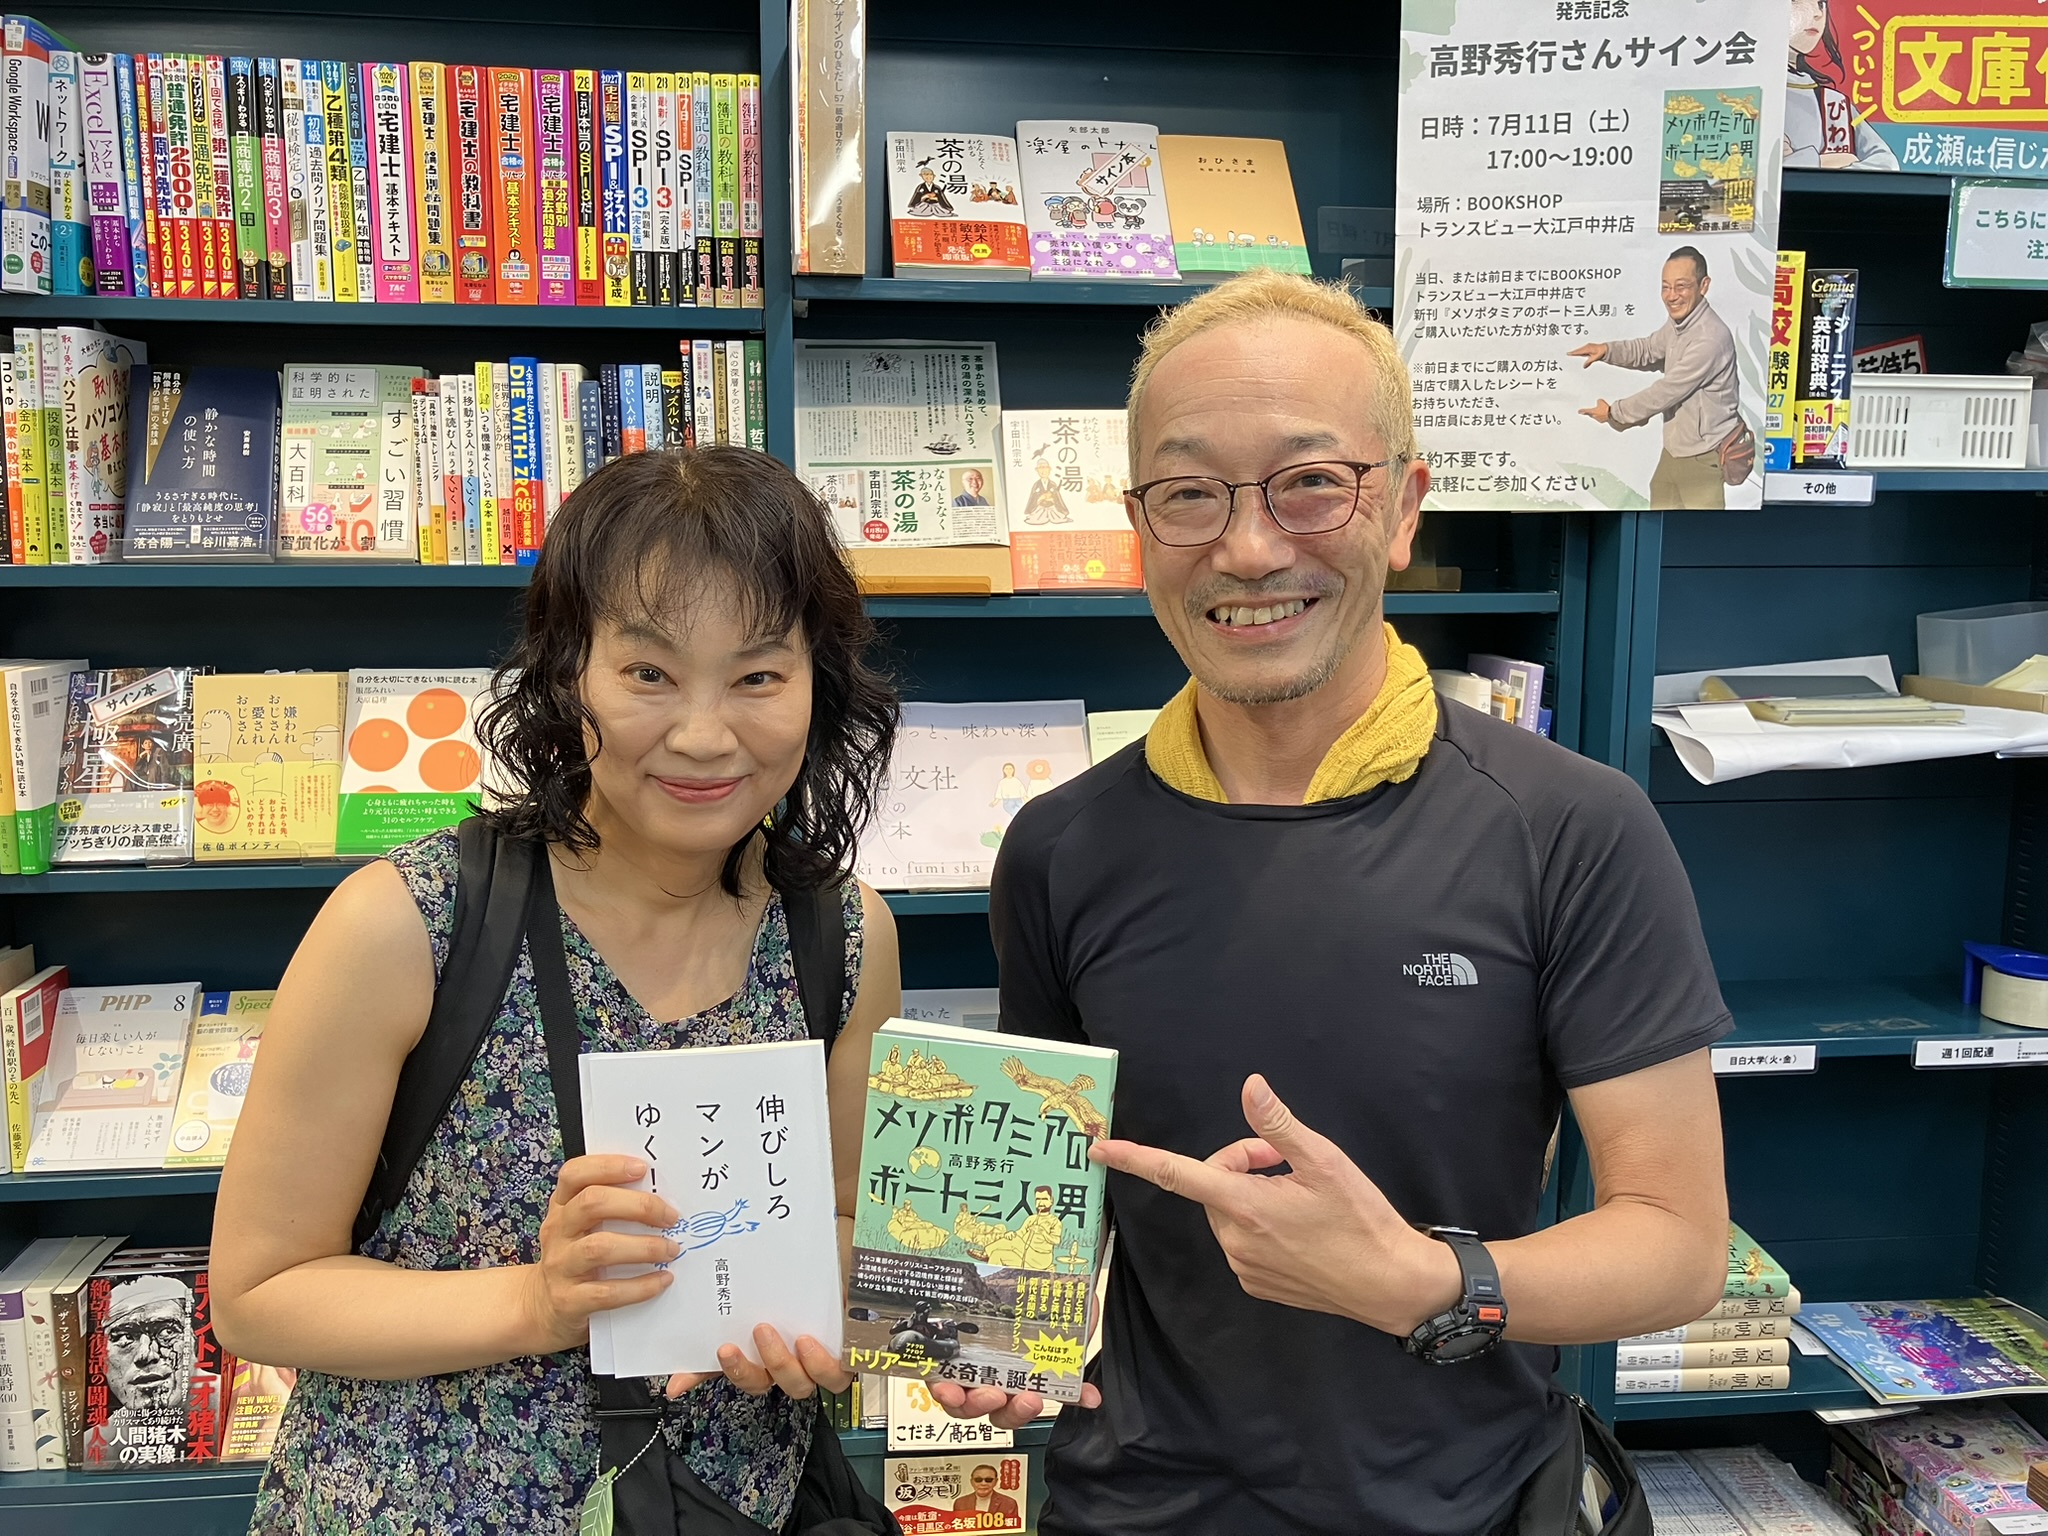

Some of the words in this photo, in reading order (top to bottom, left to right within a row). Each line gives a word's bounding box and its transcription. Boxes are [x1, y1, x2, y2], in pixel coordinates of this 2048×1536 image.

[1430, 30, 1757, 78] 高野秀行さんサイン会
[1852, 30, 1876, 104] ついに
[9, 58, 22, 94] Google
[83, 69, 112, 136] Excel
[236, 76, 248, 127] スッキリわかる
[264, 77, 275, 129] スッキリわかる
[9, 94, 22, 152] Workspace
[55, 79, 68, 163] ネットワーク
[306, 115, 322, 144] 初級
[326, 94, 348, 182] 乙種第4類
[500, 93, 520, 153] 宅建士
[542, 95, 563, 154] 宅建士
[1068, 125, 1110, 134] 矢部太郎
[1666, 111, 1755, 135] メソポタミアの
[90, 140, 101, 175] VBA
[101, 140, 113, 170] マクロ
[377, 111, 401, 177] 宅建士
[695, 100, 711, 193] 簿記の教科書
[718, 102, 735, 199] 簿記の教科書
[742, 102, 759, 199] 簿記の教科書
[895, 138, 907, 173] 宇田川宗光
[1198, 156, 1256, 167] おひさま
[193, 123, 213, 202] 普通免許
[212, 137, 232, 217] 第二種免許
[459, 100, 483, 230] 宅建士の教科書
[632, 130, 649, 208] SPI3
[655, 130, 673, 208] SPI3
[679, 154, 693, 205] SPI
[935, 138, 969, 195] 茶の湯
[1094, 149, 1138, 187] サイン本
[308, 146, 328, 257] 過去問クリア問題集
[353, 169, 369, 238] 乙種第4類
[385, 182, 402, 257] 基本テキスト
[506, 181, 522, 248] 基本テキスト
[542, 188, 556, 251] 過去問題集
[555, 189, 569, 228] 分野別
[603, 189, 613, 233] センター
[613, 189, 626, 233] テスト
[958, 223, 973, 244] 敏夫
[973, 223, 988, 244] 鈴木
[1419, 215, 1635, 238] トランスビュー大江戸中井店
[1049, 240, 1134, 250] 売れない僕らでも
[1050, 249, 1104, 258] 楽屋裏では
[1051, 257, 1122, 268] 主役になれる。
[1415, 267, 1621, 285] 当日、または前日までにBOOKSHOP
[1811, 277, 1856, 295] Genius
[1414, 303, 1636, 321] 新刊『メソポタミアのボート三人男』を
[1415, 286, 1586, 303] トランスビュー大江戸中井店で
[1414, 321, 1591, 339] ご購入いただいた方が対象です。
[1808, 315, 1832, 392] 英和辞典
[1829, 315, 1850, 401] ジーニアス
[2, 360, 14, 407] note
[291, 387, 371, 400] 証明された
[292, 371, 357, 384] 科学的に
[510, 365, 526, 399] DIE
[973, 354, 988, 418] 茶事から始めて、
[1412, 377, 1557, 393] 当店で購入したレシートを
[959, 354, 977, 450] 茶の湯の深みにハマろう。
[1412, 395, 1501, 411] お持ちいただき、
[511, 407, 525, 459] WITH
[1412, 413, 1563, 428] 当日店員にお見せください。
[181, 415, 198, 470] の使い方
[202, 407, 220, 478] 静かな時間
[1010, 420, 1023, 468] 宇田川宗光
[1051, 416, 1084, 493] 茶の湯
[286, 441, 307, 504] 大百科
[379, 408, 409, 543] すごい習慣
[917, 468, 933, 504] わかる
[1802, 482, 1837, 495] その他
[135, 501, 260, 513] 「静寂」と「最高純度の思考」
[155, 491, 244, 502] うるさすぎる時代に、
[868, 469, 884, 520] 宇田川宗光
[890, 469, 919, 534] 茶の湯
[933, 468, 948, 531] なんとなく
[171, 513, 224, 524] をとりもどせ
[304, 506, 330, 523] 56
[132, 536, 187, 550] 落合陽一
[201, 535, 253, 549] 谷川嘉浩
[279, 535, 346, 552] 習慣化が
[335, 518, 376, 553] 10
[360, 535, 377, 551] 割
[105, 680, 159, 712] サイン本
[354, 686, 396, 695] 服部みれい
[356, 675, 478, 685] 自分を大切にできない時に読む本
[236, 694, 250, 746] おじさん
[251, 705, 266, 745] 愛され
[268, 693, 282, 746] おじさん
[283, 705, 298, 745] 嫌われ
[961, 722, 1051, 739] 味わい深く
[9, 682, 28, 798] 自分を大切にできない時に読む本
[257, 798, 266, 836] どうすれば
[268, 798, 277, 836] おじさんは
[362, 807, 458, 816] より元気になりたい時もできる
[893, 801, 907, 814] の
[201, 841, 282, 852] 佐伯ポインティ
[889, 820, 914, 841] 本
[881, 863, 899, 876] to
[906, 861, 947, 875] fumi
[953, 862, 981, 875] sha
[1402, 963, 1452, 976] NORTH
[1421, 953, 1450, 965] THE
[1417, 974, 1453, 987] FACE
[99, 994, 153, 1013] PHP
[172, 994, 187, 1013] 8
[903, 1007, 951, 1021] 続いた
[75, 1031, 158, 1046] 毎日楽しい人が
[80, 1044, 145, 1058] 「しない」こと
[11, 1122, 24, 1161] 佐藤愛子
[635, 1102, 662, 1194] ゆく！
[695, 1102, 730, 1191] マンが
[873, 1099, 1096, 1173] メソポタミアの
[755, 1093, 792, 1221] 伸びしろ
[947, 1152, 1016, 1175] 高野秀行
[869, 1163, 1089, 1230] ボート三人男
[714, 1257, 734, 1317] 高野秀行
[1735, 1320, 1776, 1339] 夏帆
[1032, 1353, 1078, 1365] じゃなかった！
[1033, 1343, 1070, 1355] こんなはず
[1731, 1346, 1774, 1365] 夏帆
[86, 1278, 112, 1466] 絶望と復活の闘魂人生
[1730, 1372, 1774, 1390] 夏帆
[236, 1395, 256, 1406] NEW
[109, 1425, 187, 1447] 人間猪木
[112, 1415, 184, 1426] カリスマであり続けた
[119, 1444, 176, 1465] の実像
